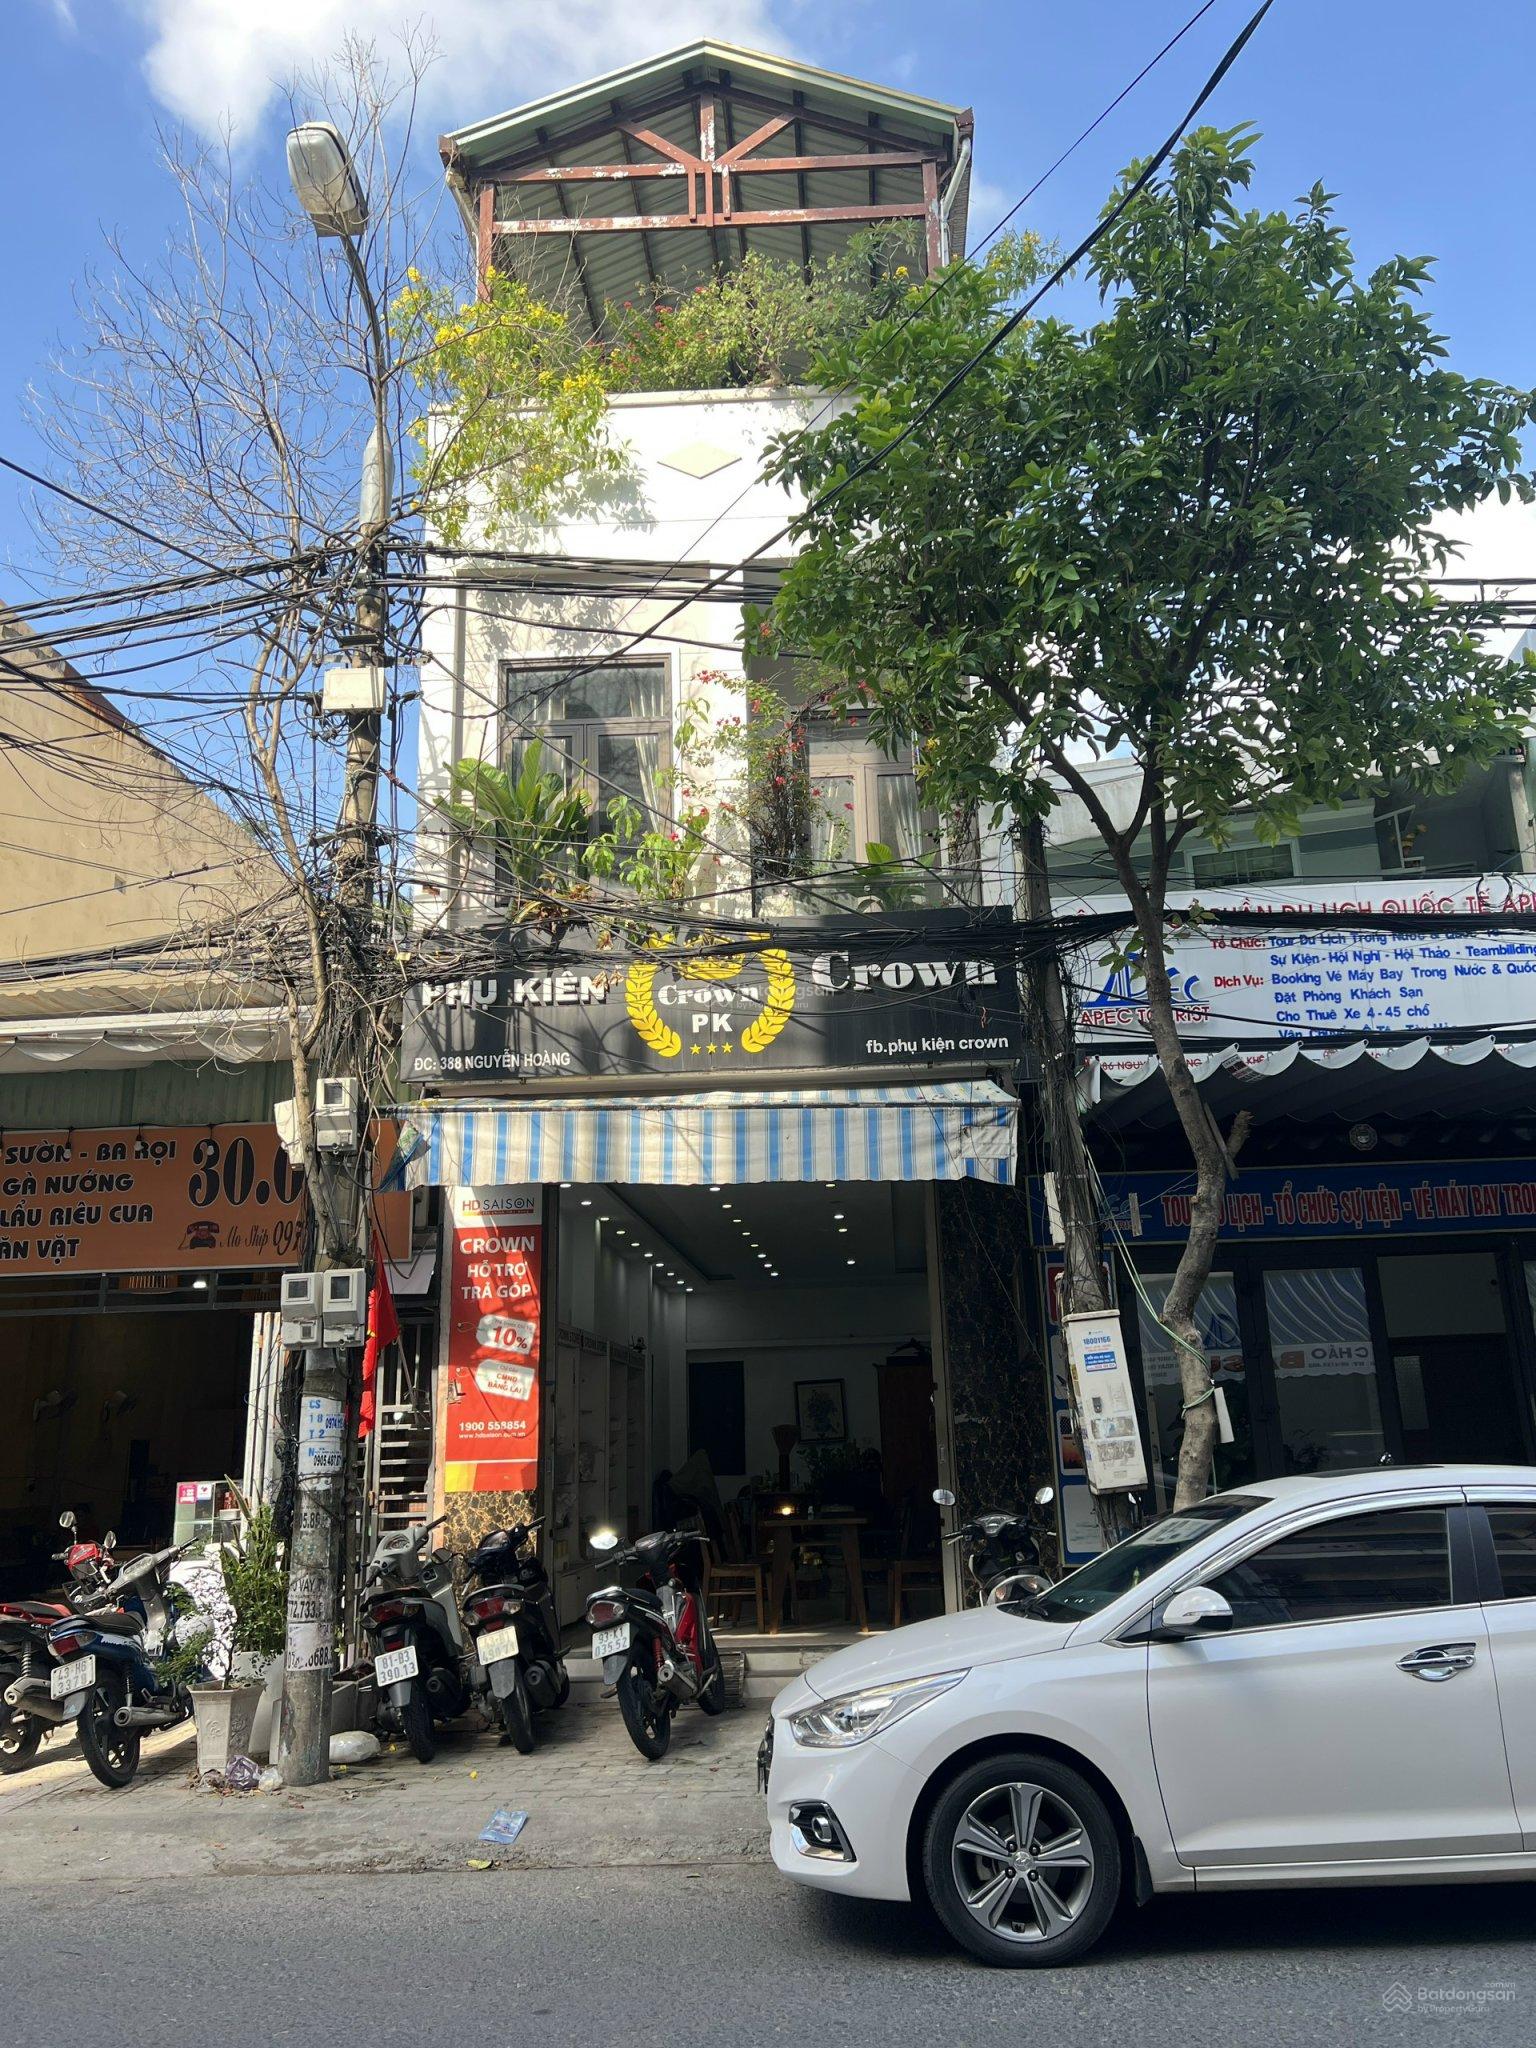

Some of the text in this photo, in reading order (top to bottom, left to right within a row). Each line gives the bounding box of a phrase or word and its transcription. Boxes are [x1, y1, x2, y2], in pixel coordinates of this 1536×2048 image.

[1352, 931, 1388, 945] Trong
[1292, 952, 1320, 966] Kiện
[1329, 952, 1349, 965] Hội
[1353, 950, 1381, 965] Nghị
[1394, 948, 1414, 962] Hội
[1419, 945, 1451, 960] Thảo
[811, 950, 998, 992] Crown
[1214, 975, 1241, 989] Dịch
[1243, 974, 1264, 988] Vụ:
[1271, 972, 1322, 986] Booking
[1326, 970, 1342, 982] Vé
[1348, 969, 1374, 983] Máy
[1380, 968, 1403, 982] Bay
[1411, 966, 1447, 980] Trong
[1454, 963, 1487, 977] Nước
[1492, 963, 1502, 975] &
[421, 979, 498, 1010] PHỤ
[658, 984, 760, 1006] Crown
[1274, 986, 1424, 1005] Đặt Phòng Khách Sạn
[692, 1013, 734, 1034] PK
[1081, 1008, 1133, 1026] APEC
[1276, 1011, 1300, 1023] Cho
[1306, 1009, 1337, 1021] Thuê
[1343, 1008, 1361, 1020] Xe
[1367, 1007, 1376, 1018] 4
[1385, 1006, 1401, 1018] 45
[1407, 1003, 1430, 1017] chỗ
[866, 1036, 1009, 1056] fb.phụ kiện crown
[414, 1049, 571, 1072] ĐC: 388 NGUYỄN HOÀNG
[4, 1140, 71, 1166] SƯỜN
[96, 1141, 127, 1162] BA
[134, 1139, 177, 1167] RỌI
[2, 1169, 135, 1197] GÀ NƯỚNG
[0, 1199, 154, 1229] LẨU RIÊU CUA
[462, 1197, 535, 1212] HD SAISON
[1226, 1192, 1265, 1233] LỊCH
[1272, 1180, 1298, 1225] TỔ
[1297, 1185, 1340, 1226] CHỨC
[1339, 1187, 1364, 1230] SỰ
[1363, 1182, 1403, 1229] KIỆN
[1410, 1180, 1435, 1220] VÉ
[1433, 1179, 1470, 1219] MÁY
[1469, 1183, 1501, 1217] BAY
[36, 1233, 81, 1266] VẶT
[460, 1236, 535, 1255] CROWN
[467, 1260, 528, 1280] HỖ TRỢ
[461, 1281, 532, 1300] TRẢ GÓP
[493, 1326, 528, 1350] 10%
[459, 1421, 485, 1431] 1900
